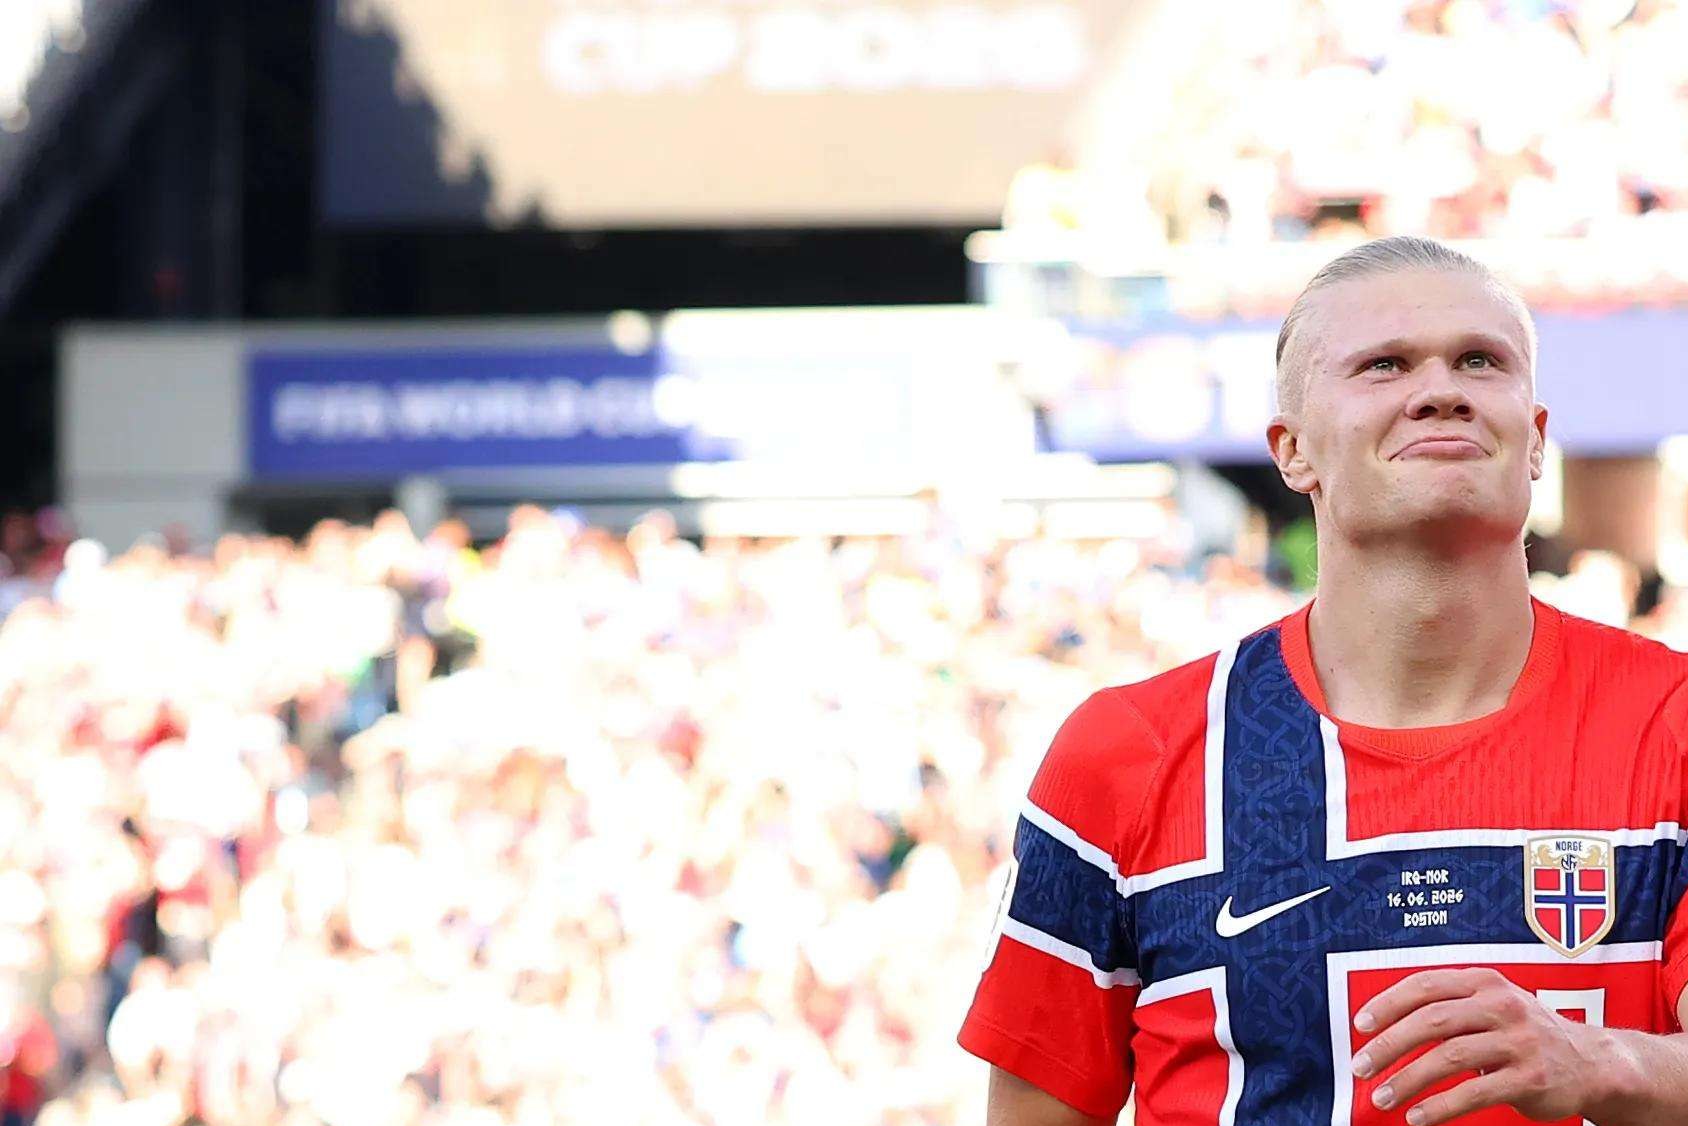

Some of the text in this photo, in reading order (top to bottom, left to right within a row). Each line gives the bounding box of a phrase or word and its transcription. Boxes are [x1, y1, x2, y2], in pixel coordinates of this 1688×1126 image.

[1555, 841, 1582, 851] NORGE
[1401, 869, 1449, 886] IRQ-NOR
[1404, 910, 1447, 928] BOSTON
